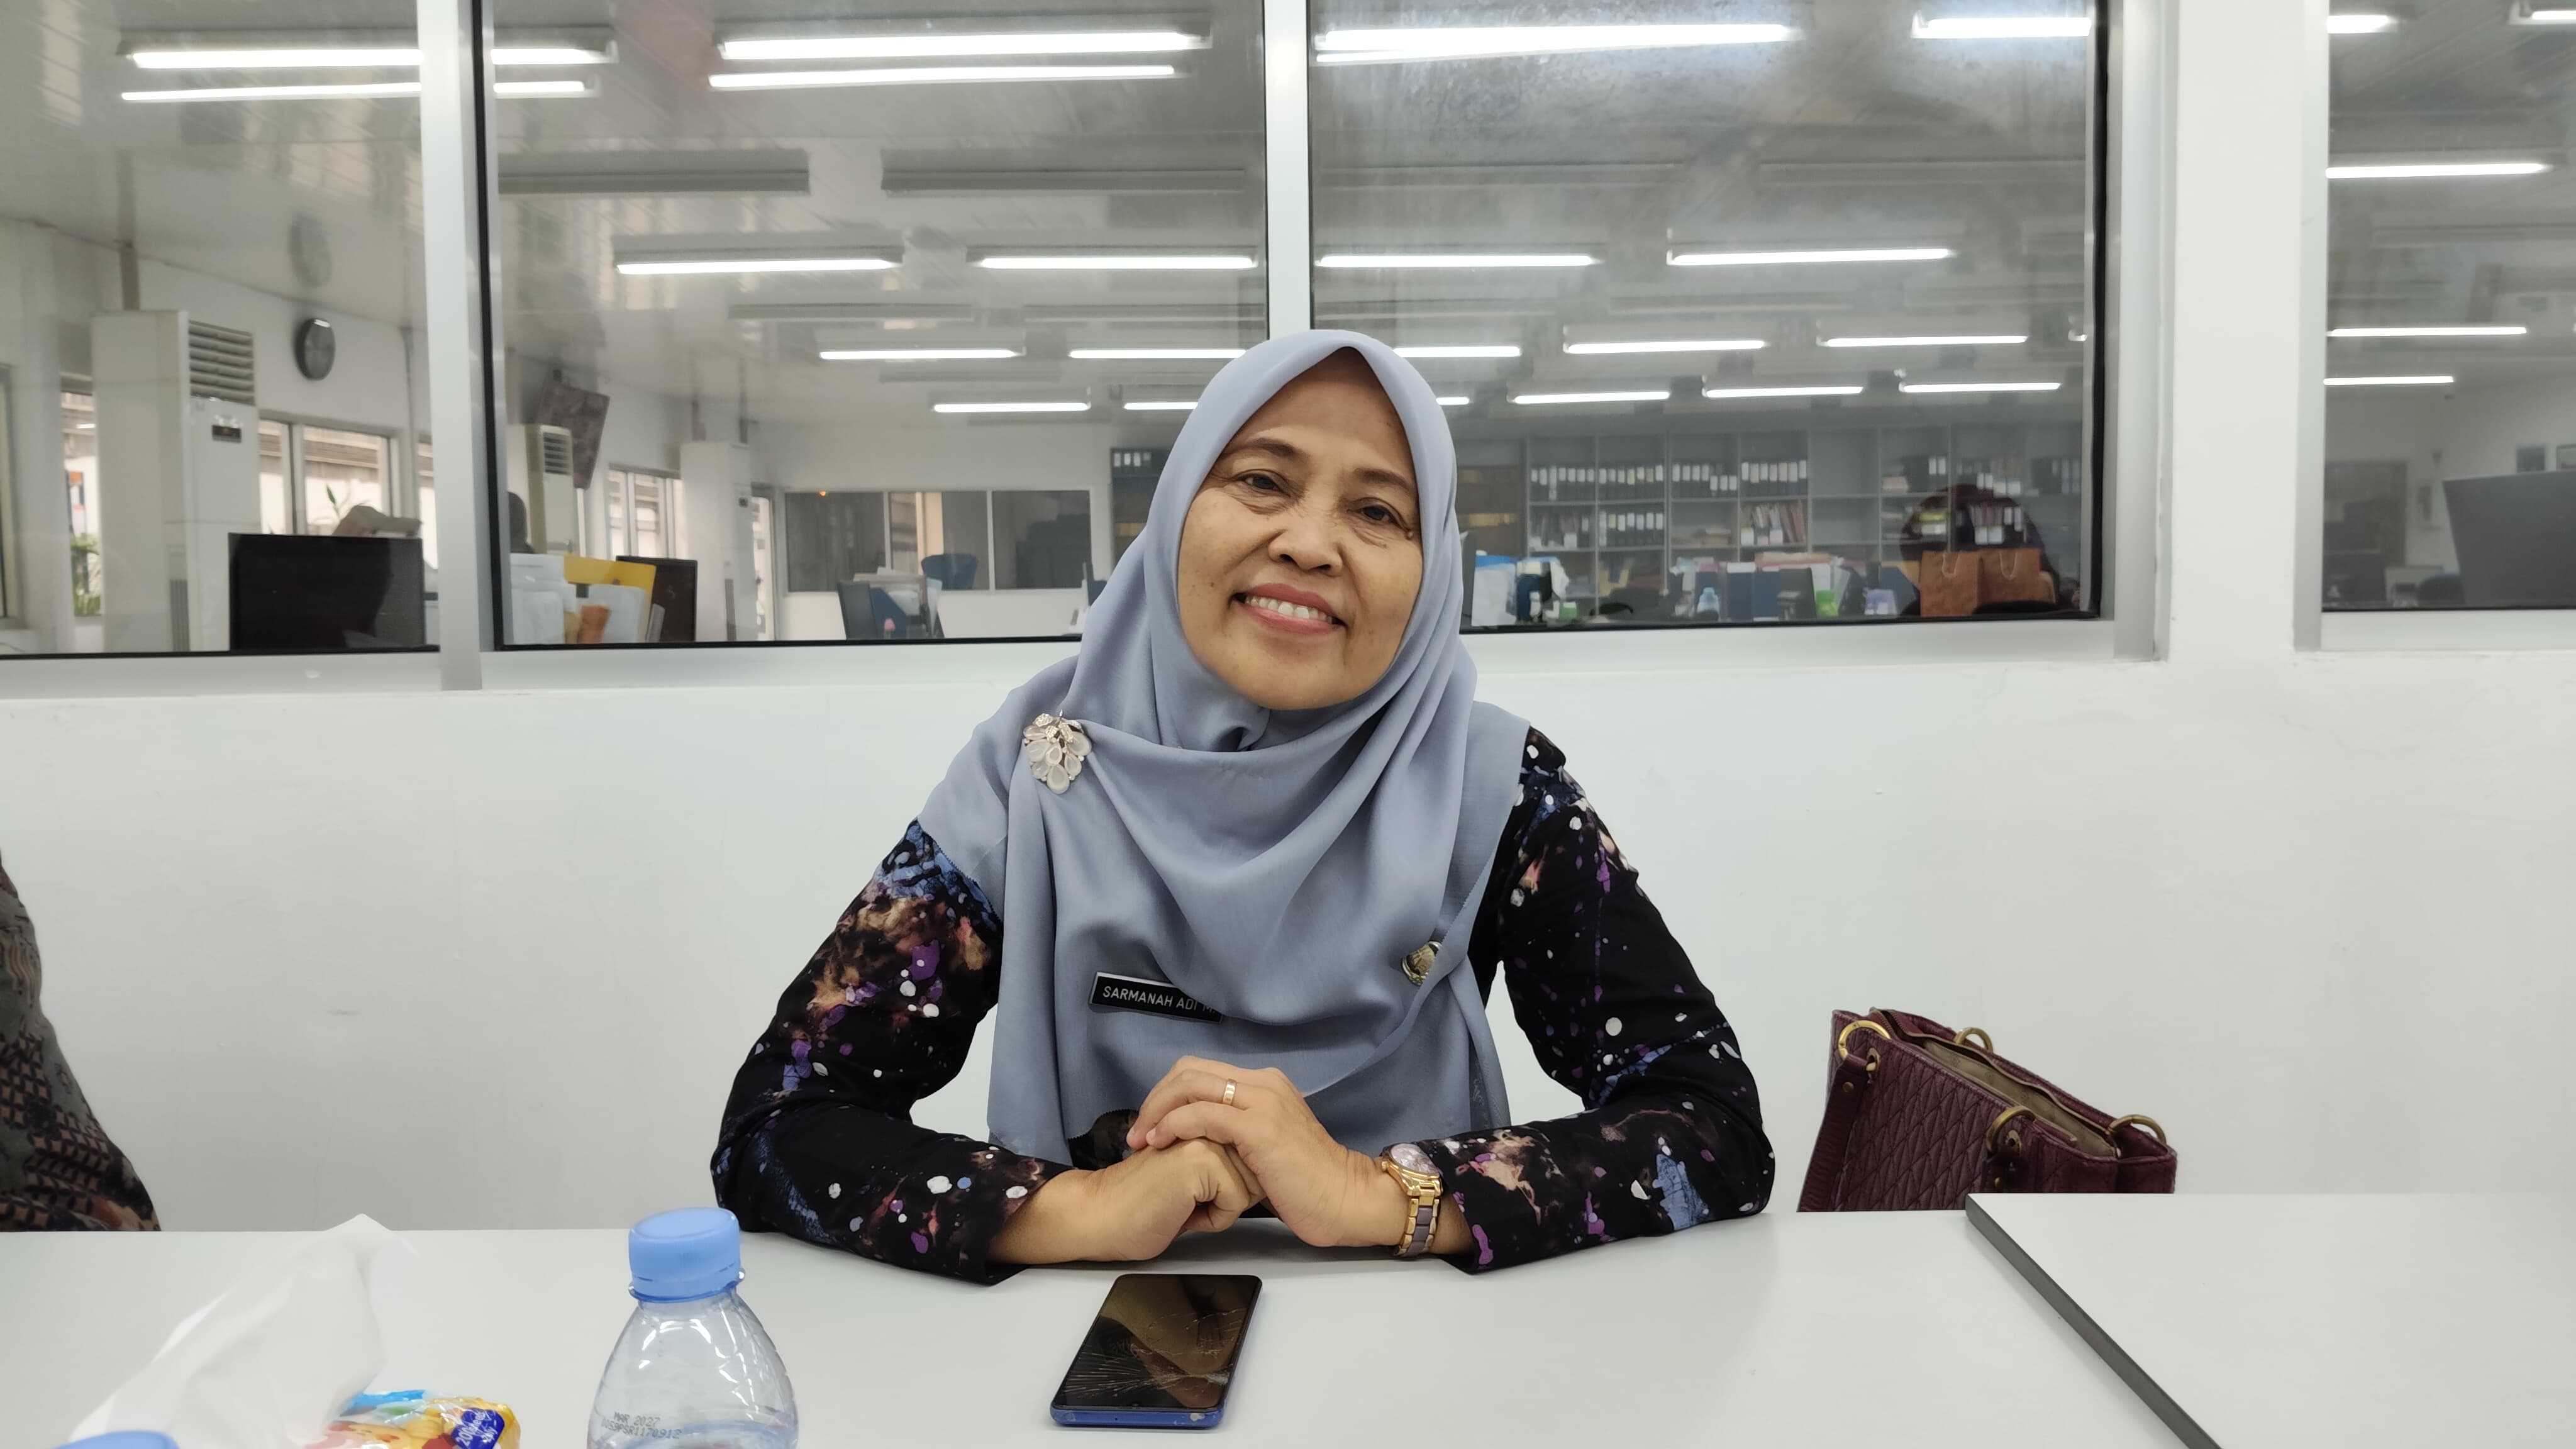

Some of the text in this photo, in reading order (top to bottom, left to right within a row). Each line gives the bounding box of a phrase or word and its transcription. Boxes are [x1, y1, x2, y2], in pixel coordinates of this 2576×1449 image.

[1102, 985, 1174, 1008] SARMANAH
[1175, 997, 1198, 1011] ADI
[613, 1411, 661, 1427] MAR 2027
